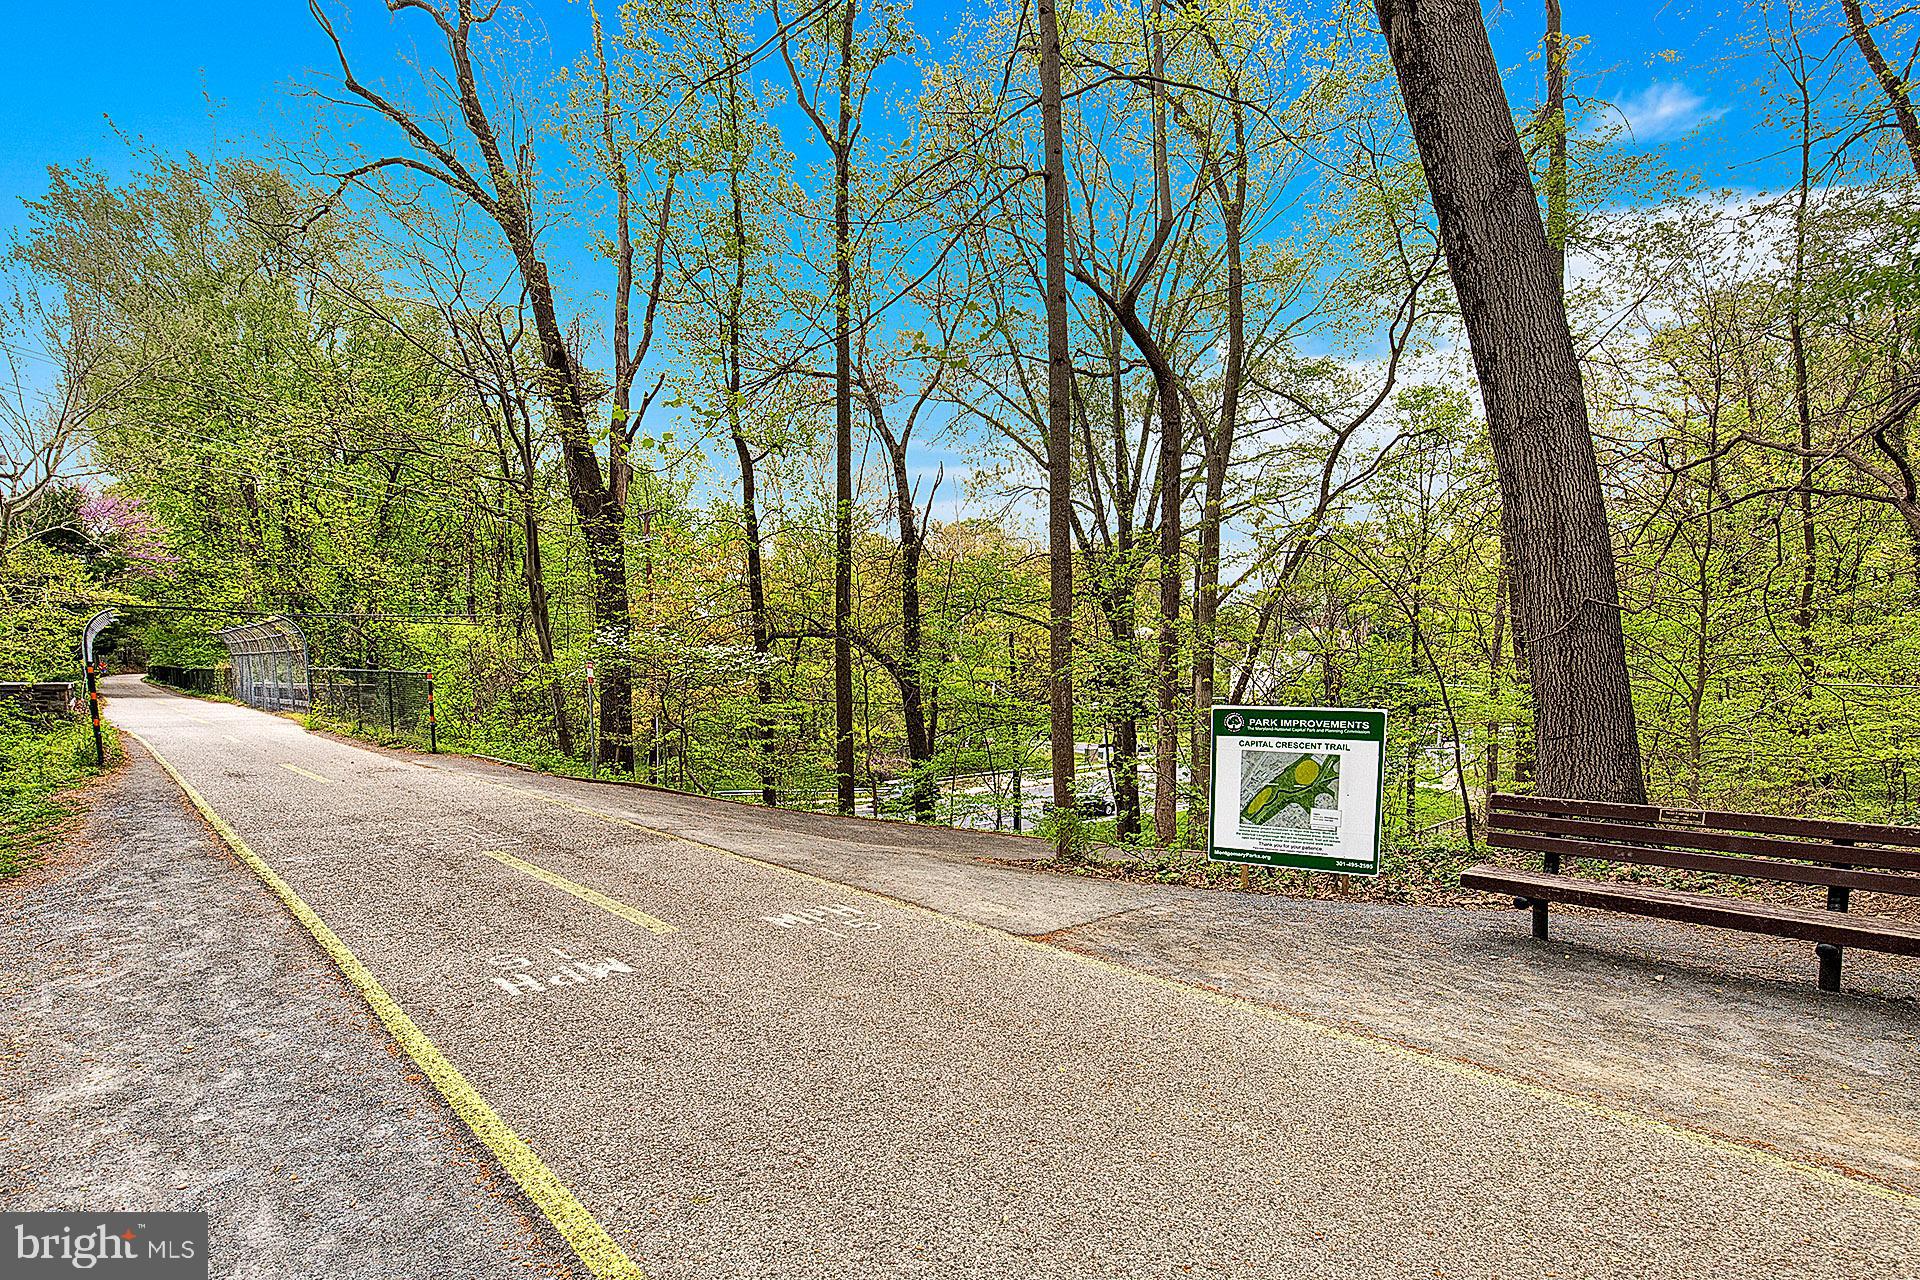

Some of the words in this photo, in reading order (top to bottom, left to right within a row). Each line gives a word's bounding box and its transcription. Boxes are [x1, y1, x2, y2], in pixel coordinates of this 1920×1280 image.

[1249, 718, 1278, 727] PARK
[1280, 719, 1370, 730] IMPROVEMENTS
[1238, 739, 1273, 749] CAPITAL
[1275, 740, 1322, 750] CRESCENT
[1324, 742, 1351, 752] TRAIL
